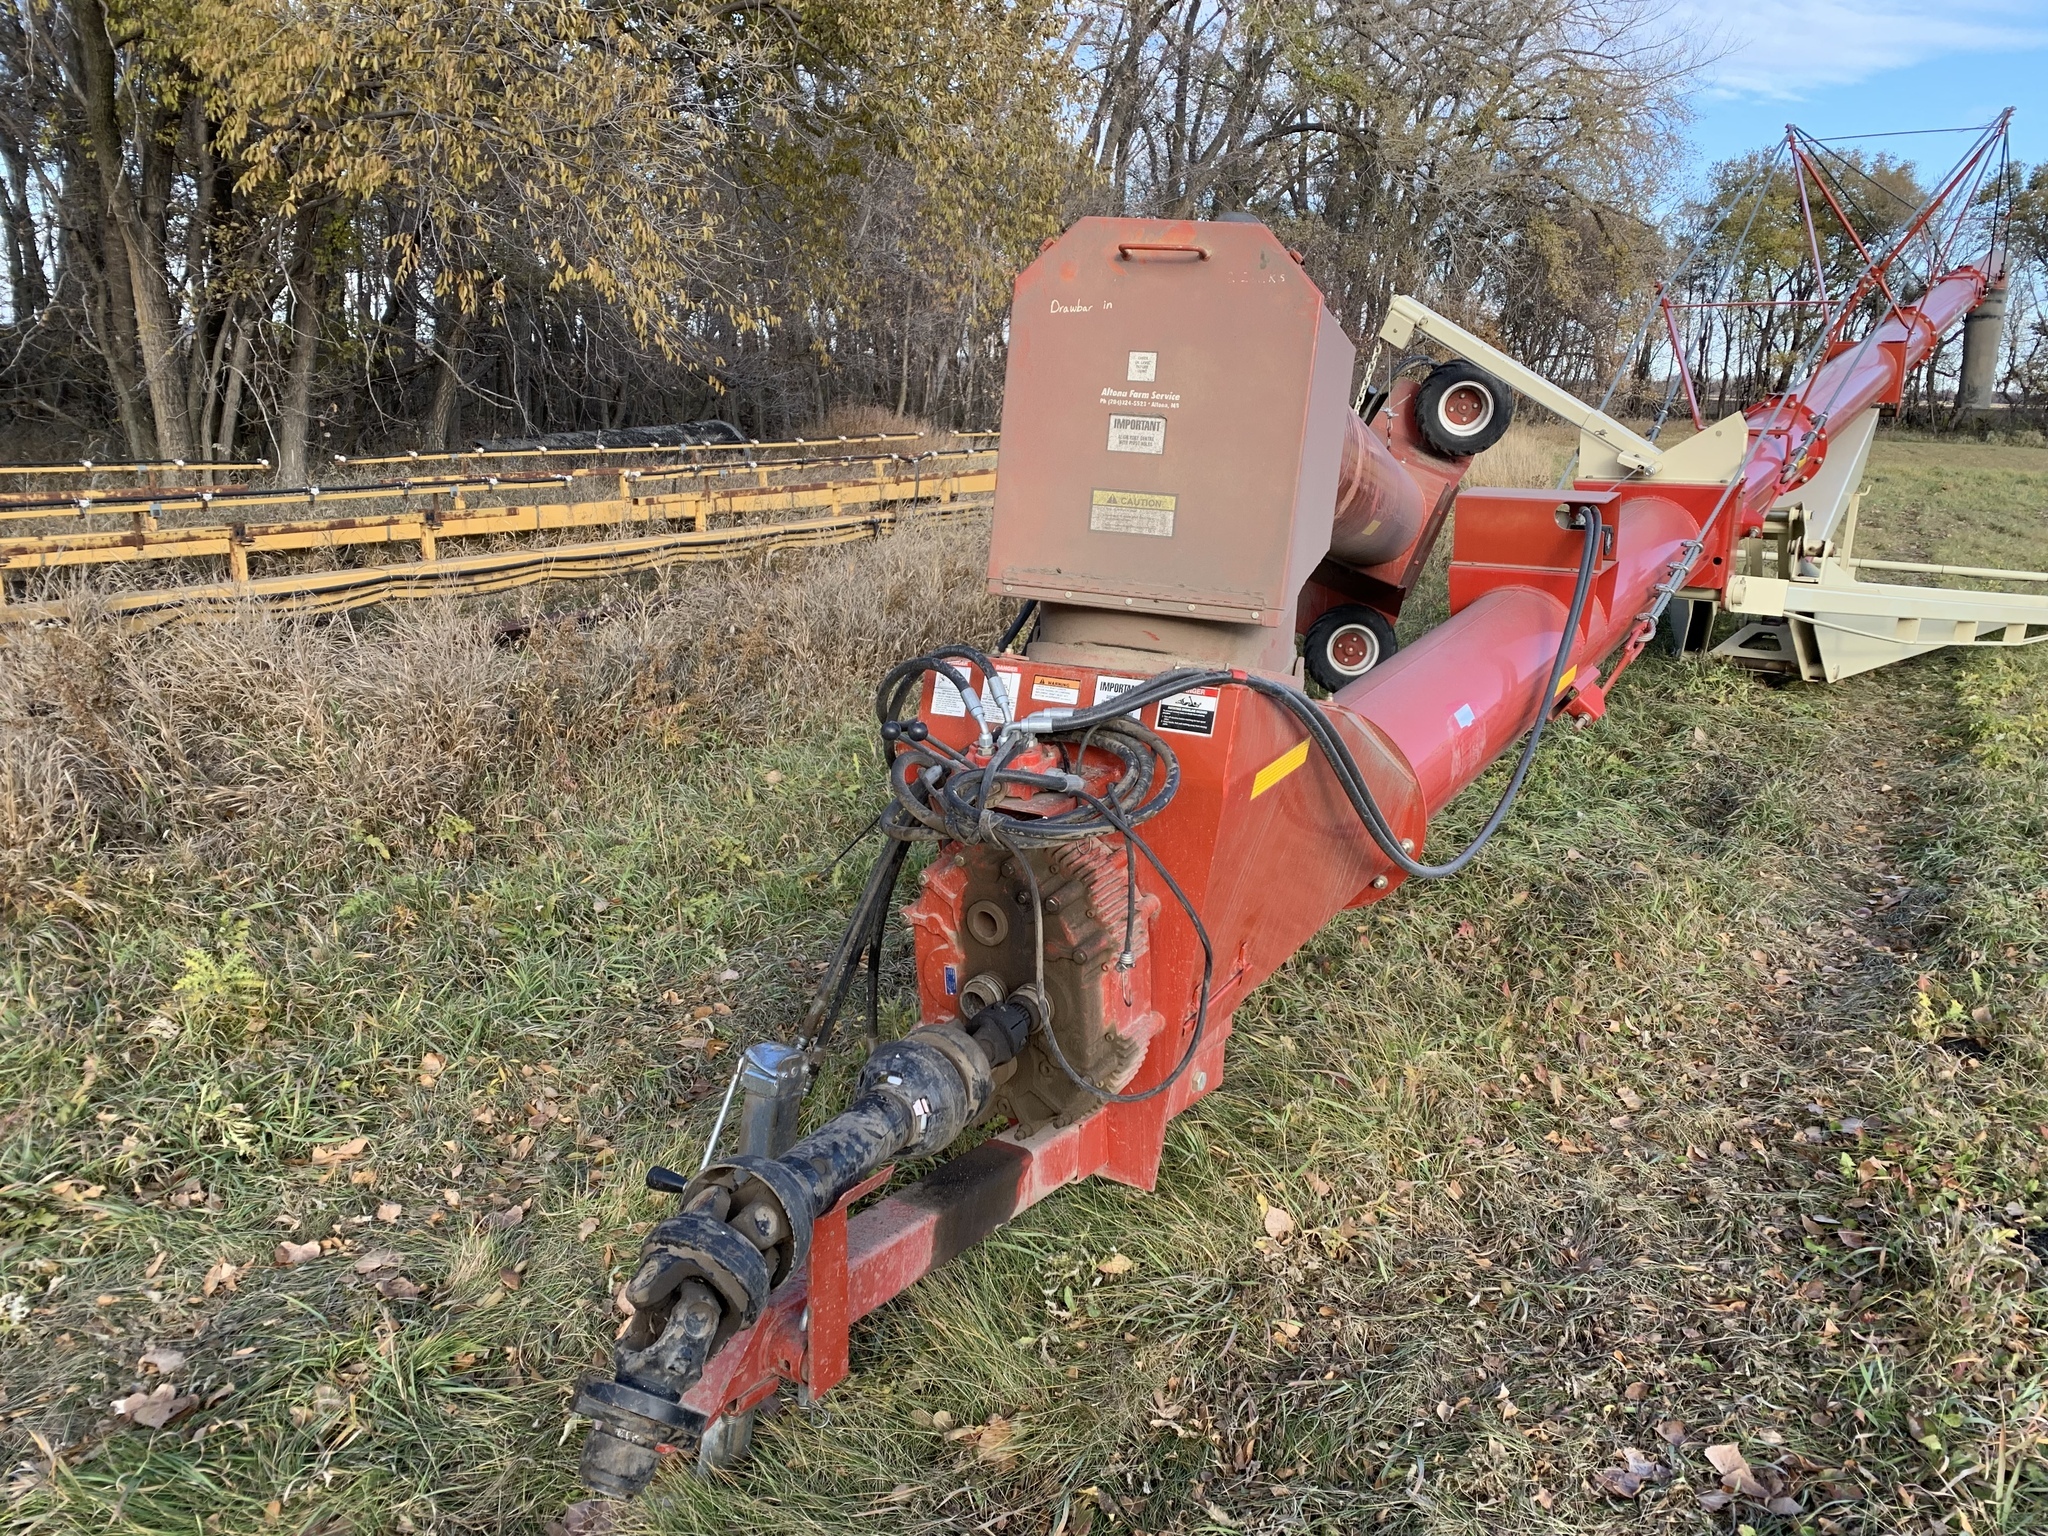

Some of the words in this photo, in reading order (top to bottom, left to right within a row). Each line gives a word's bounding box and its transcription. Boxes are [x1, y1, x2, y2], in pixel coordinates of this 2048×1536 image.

[1050, 298, 1094, 314] Drawbar
[1103, 300, 1113, 310] in
[1101, 387, 1128, 398] Altona
[1129, 389, 1150, 399] Farm
[1151, 391, 1181, 401] Service
[1113, 418, 1161, 432] IMPORTANT
[1120, 497, 1162, 508] CAUTION
[995, 664, 1018, 672] DANGER
